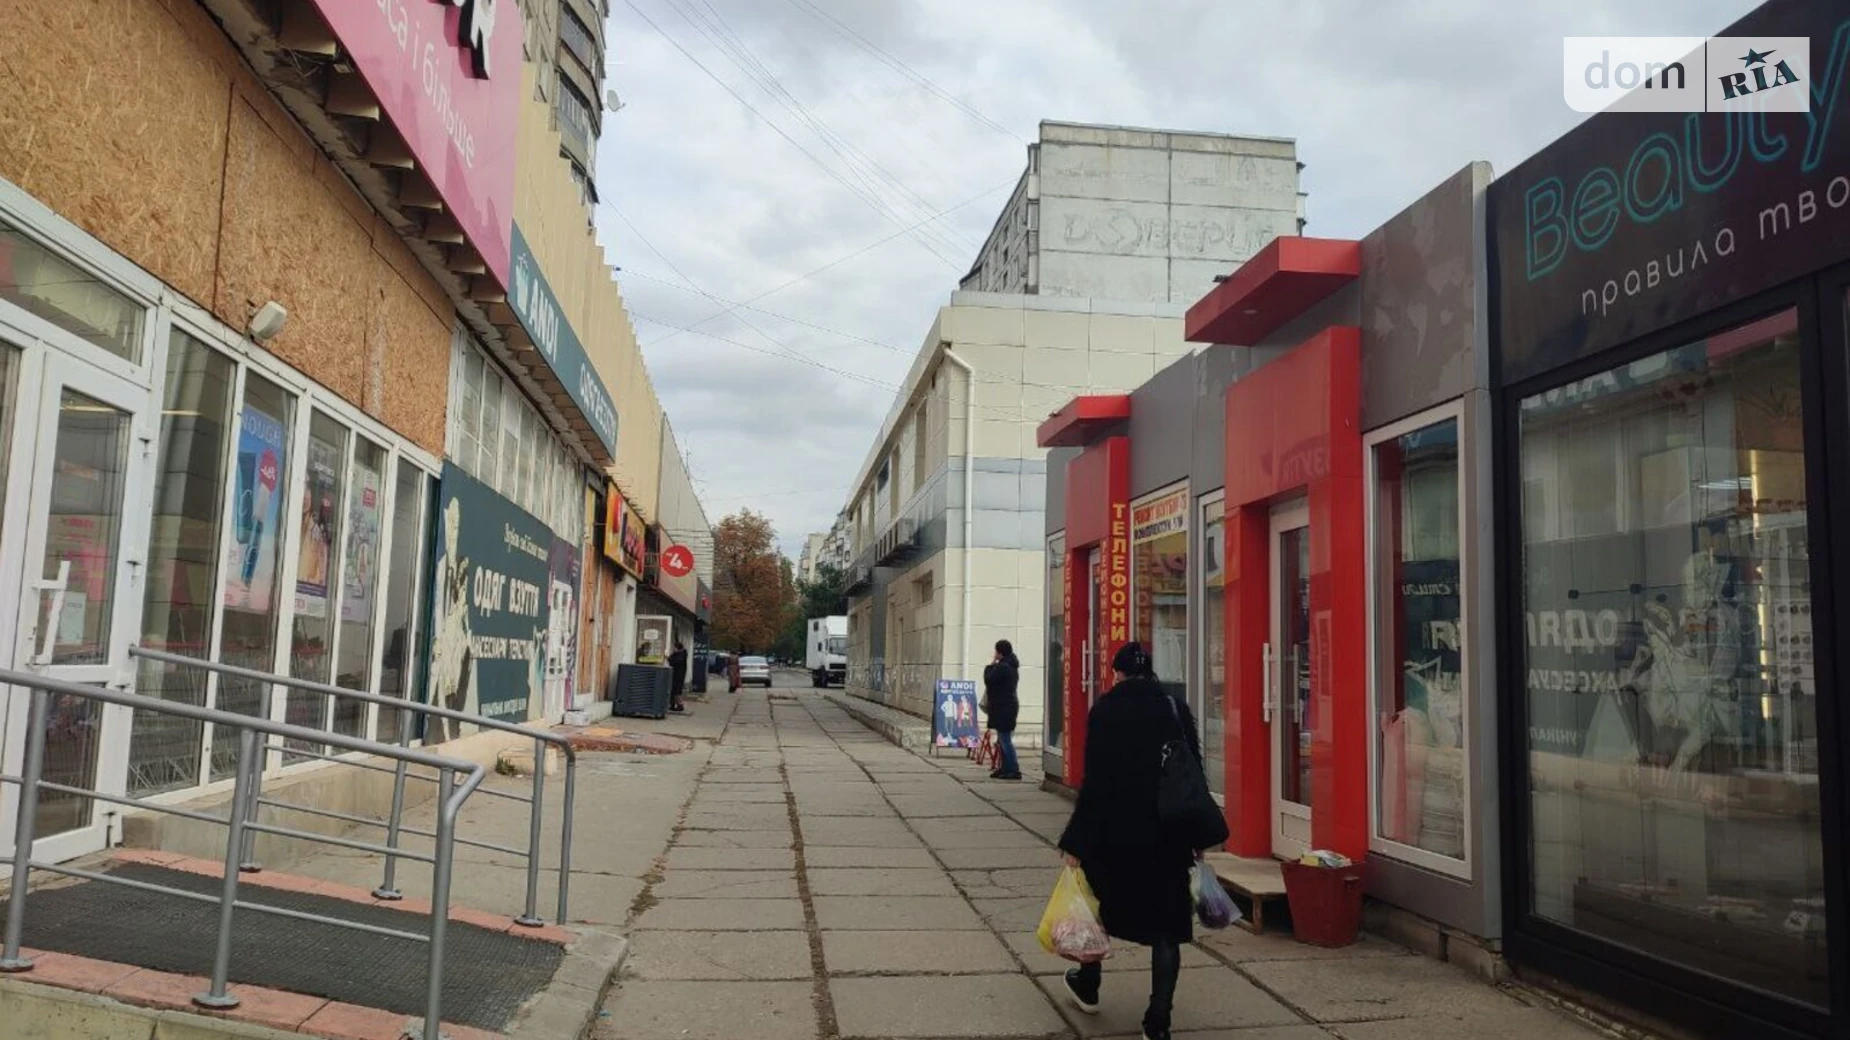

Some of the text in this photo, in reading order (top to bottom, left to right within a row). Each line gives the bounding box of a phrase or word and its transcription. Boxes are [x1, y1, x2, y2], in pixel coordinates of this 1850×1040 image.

[422, 41, 475, 169] більше
[1524, 21, 1850, 281] Beauty
[1582, 227, 1736, 317] правила
[528, 277, 559, 363] ANDI
[473, 565, 540, 618] ОДЯГ ВЗУТТЯ
[1110, 503, 1127, 641] ТЕЛЕФОНИ
[950, 681, 974, 690] ANDI
